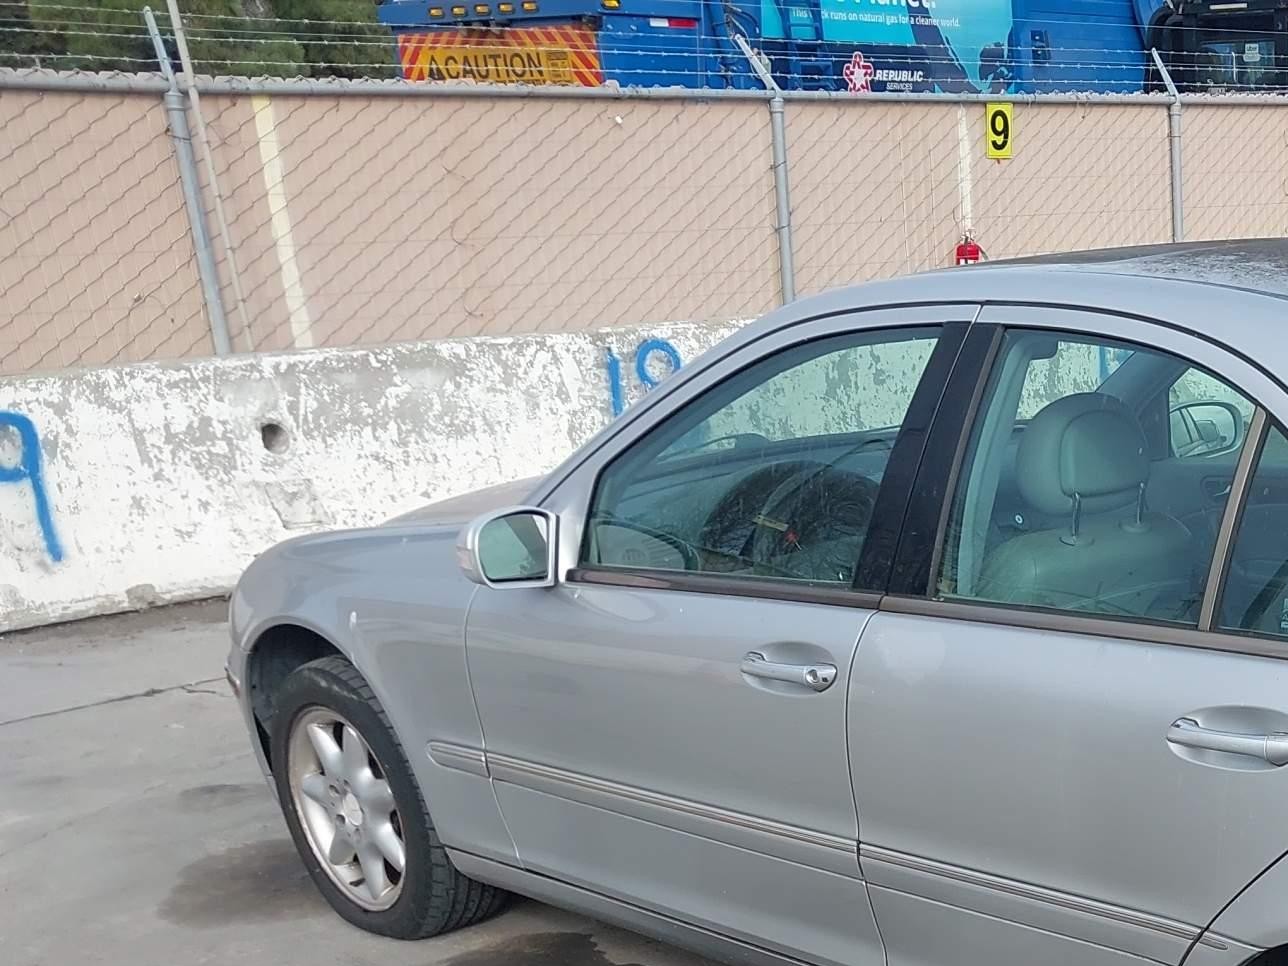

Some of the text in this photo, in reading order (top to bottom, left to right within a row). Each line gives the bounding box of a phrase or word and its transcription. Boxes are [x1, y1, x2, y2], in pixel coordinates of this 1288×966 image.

[792, 10, 808, 18] This
[830, 12, 847, 21] runs
[848, 13, 858, 21] on
[859, 12, 885, 23] natural
[886, 15, 898, 25] gas
[898, 14, 909, 24] for
[915, 15, 939, 26] cleaner
[444, 52, 545, 80] CAUTION
[875, 69, 924, 82] REPUBLIC
[886, 82, 913, 90] SERVICES
[990, 109, 1010, 151] 9
